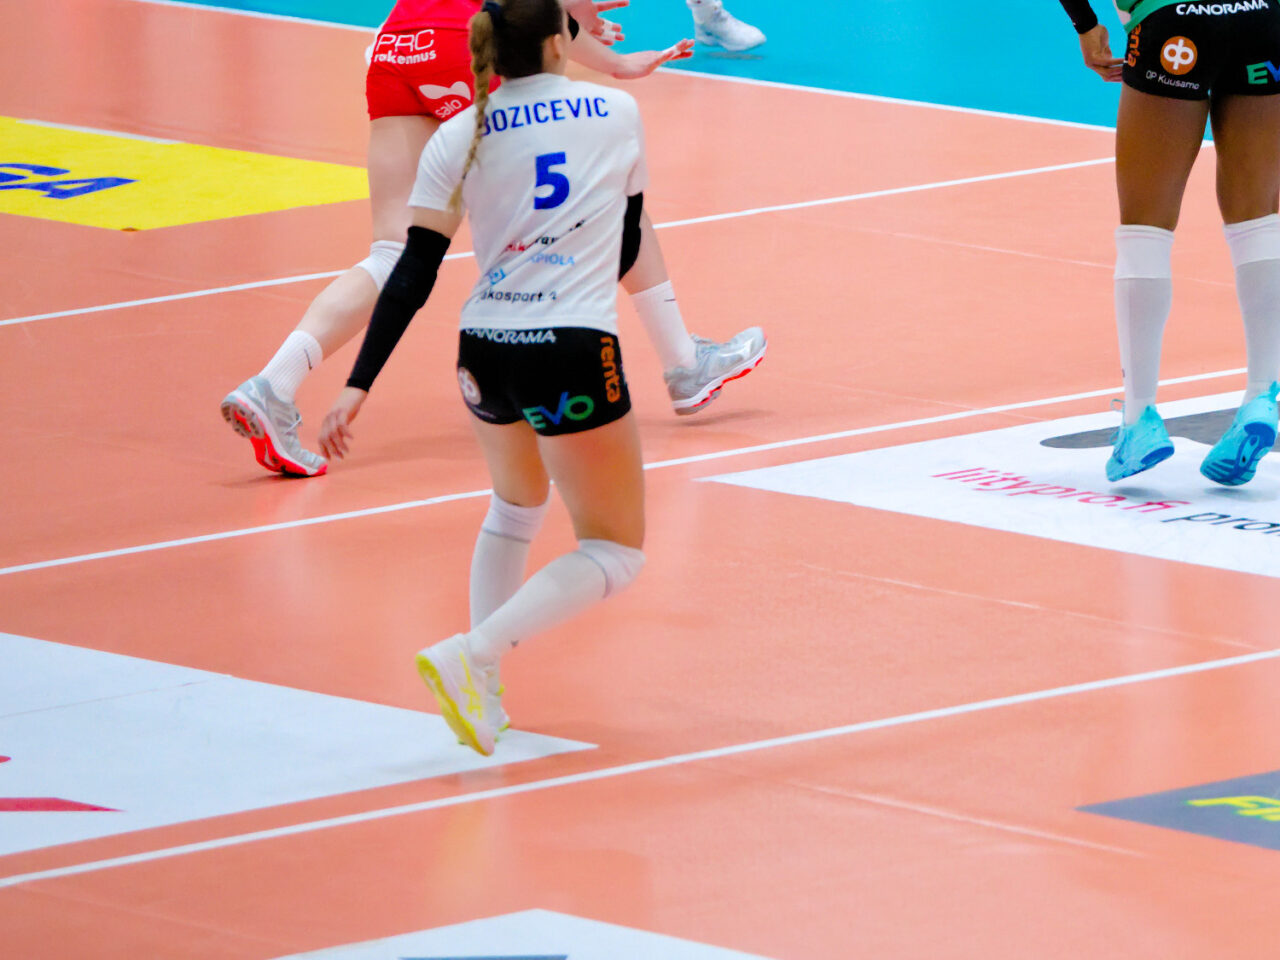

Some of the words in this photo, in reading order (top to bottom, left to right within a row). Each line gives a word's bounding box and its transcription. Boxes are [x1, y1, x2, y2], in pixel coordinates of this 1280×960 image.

[374, 49, 437, 65] rakennus
[435, 99, 463, 119] salo
[534, 151, 570, 210] 5
[599, 336, 621, 404] renta
[522, 391, 595, 430] EVO
[932, 467, 1192, 514] liitypro.fi
